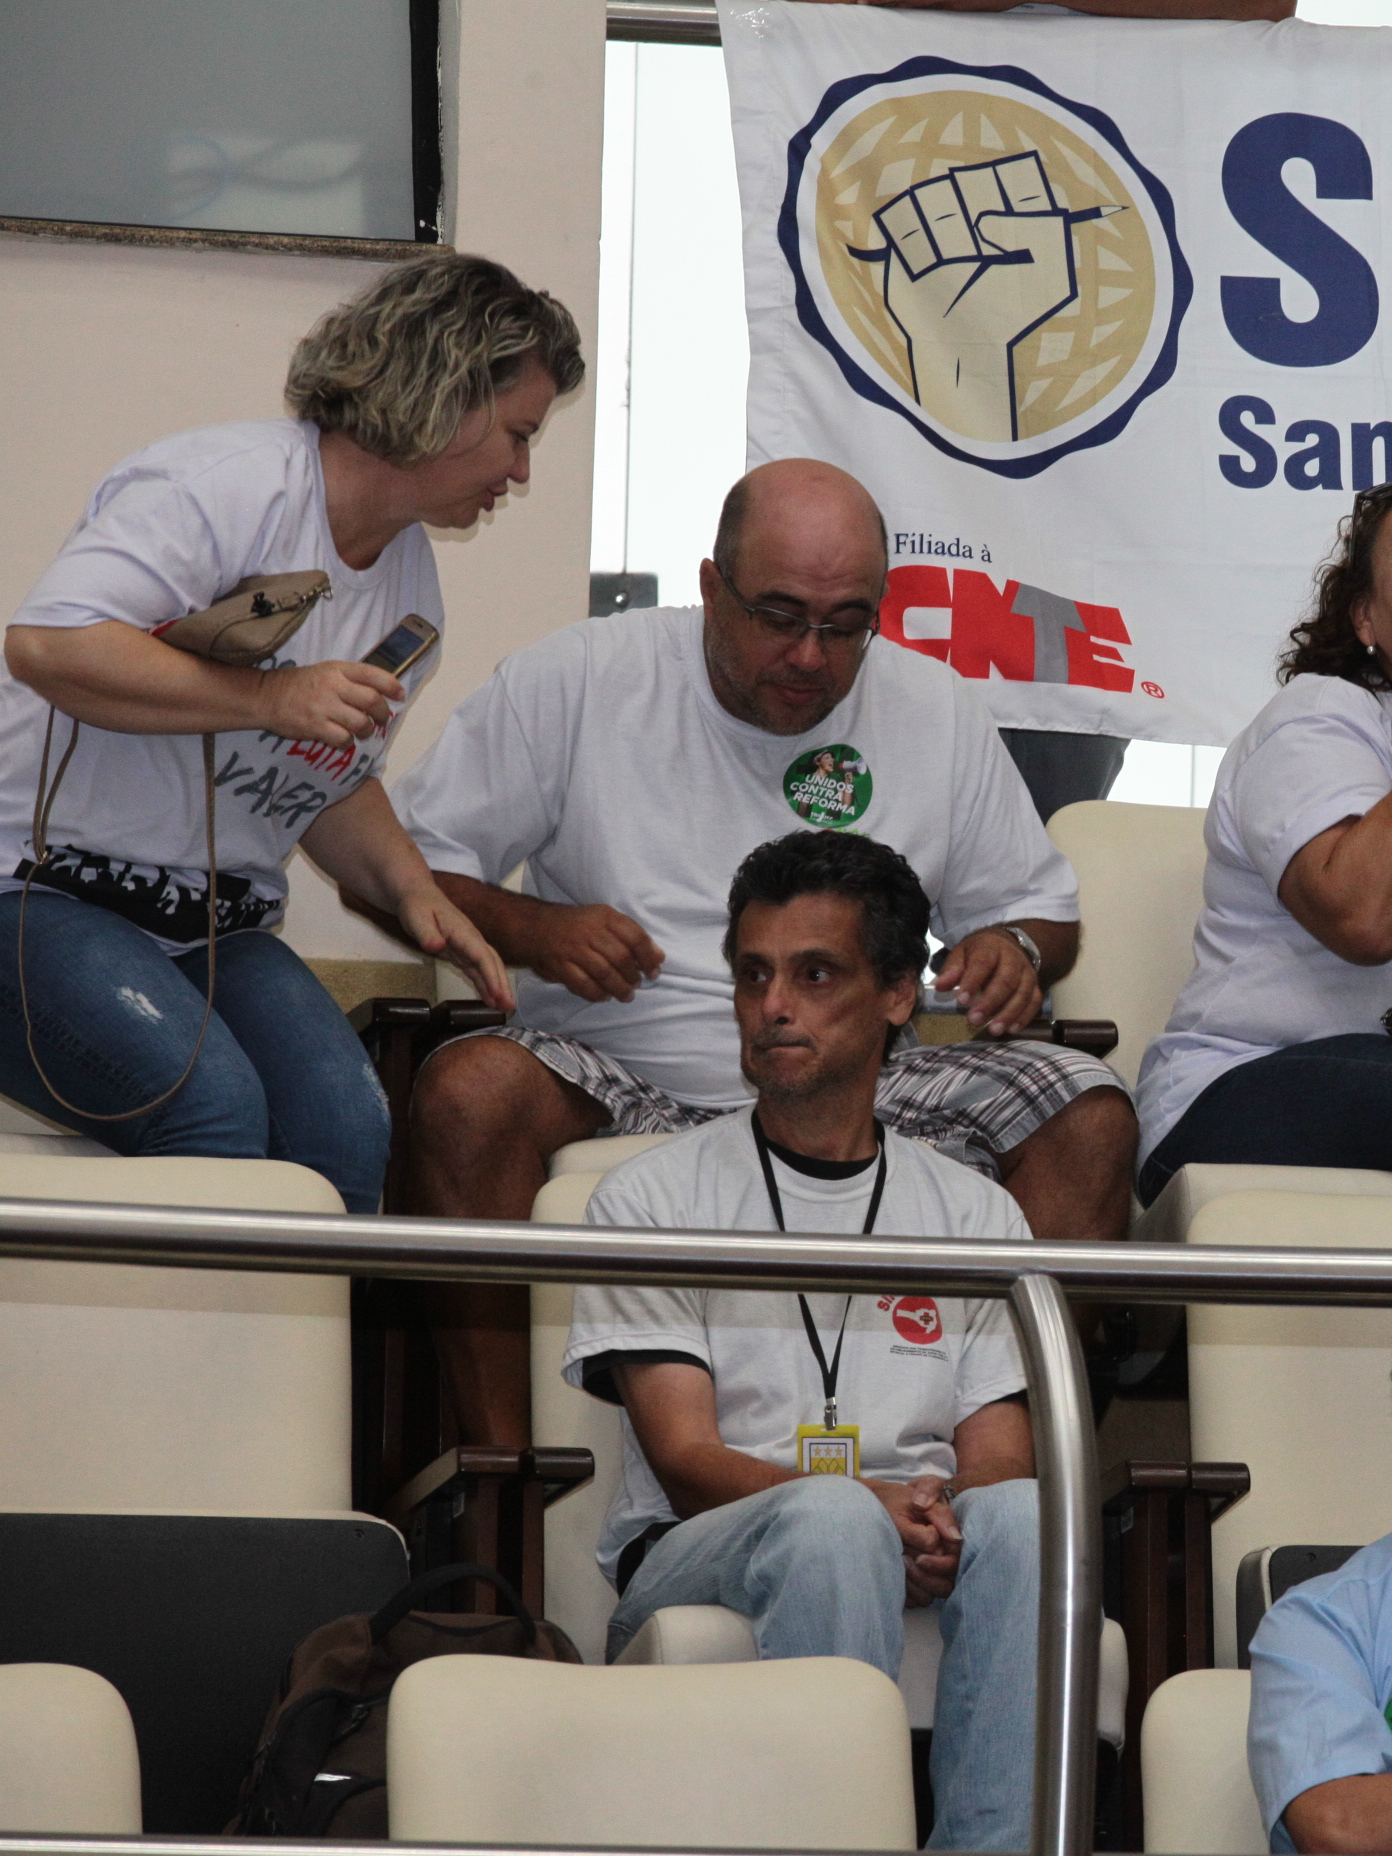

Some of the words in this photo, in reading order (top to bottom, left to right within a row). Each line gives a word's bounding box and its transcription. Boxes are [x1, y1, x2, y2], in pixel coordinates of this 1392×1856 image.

[893, 533, 974, 560] Filiada
[980, 543, 993, 564] à
[790, 782, 843, 802] CONTRA
[805, 774, 854, 794] UNIDOS
[793, 791, 856, 815] REFORMA
